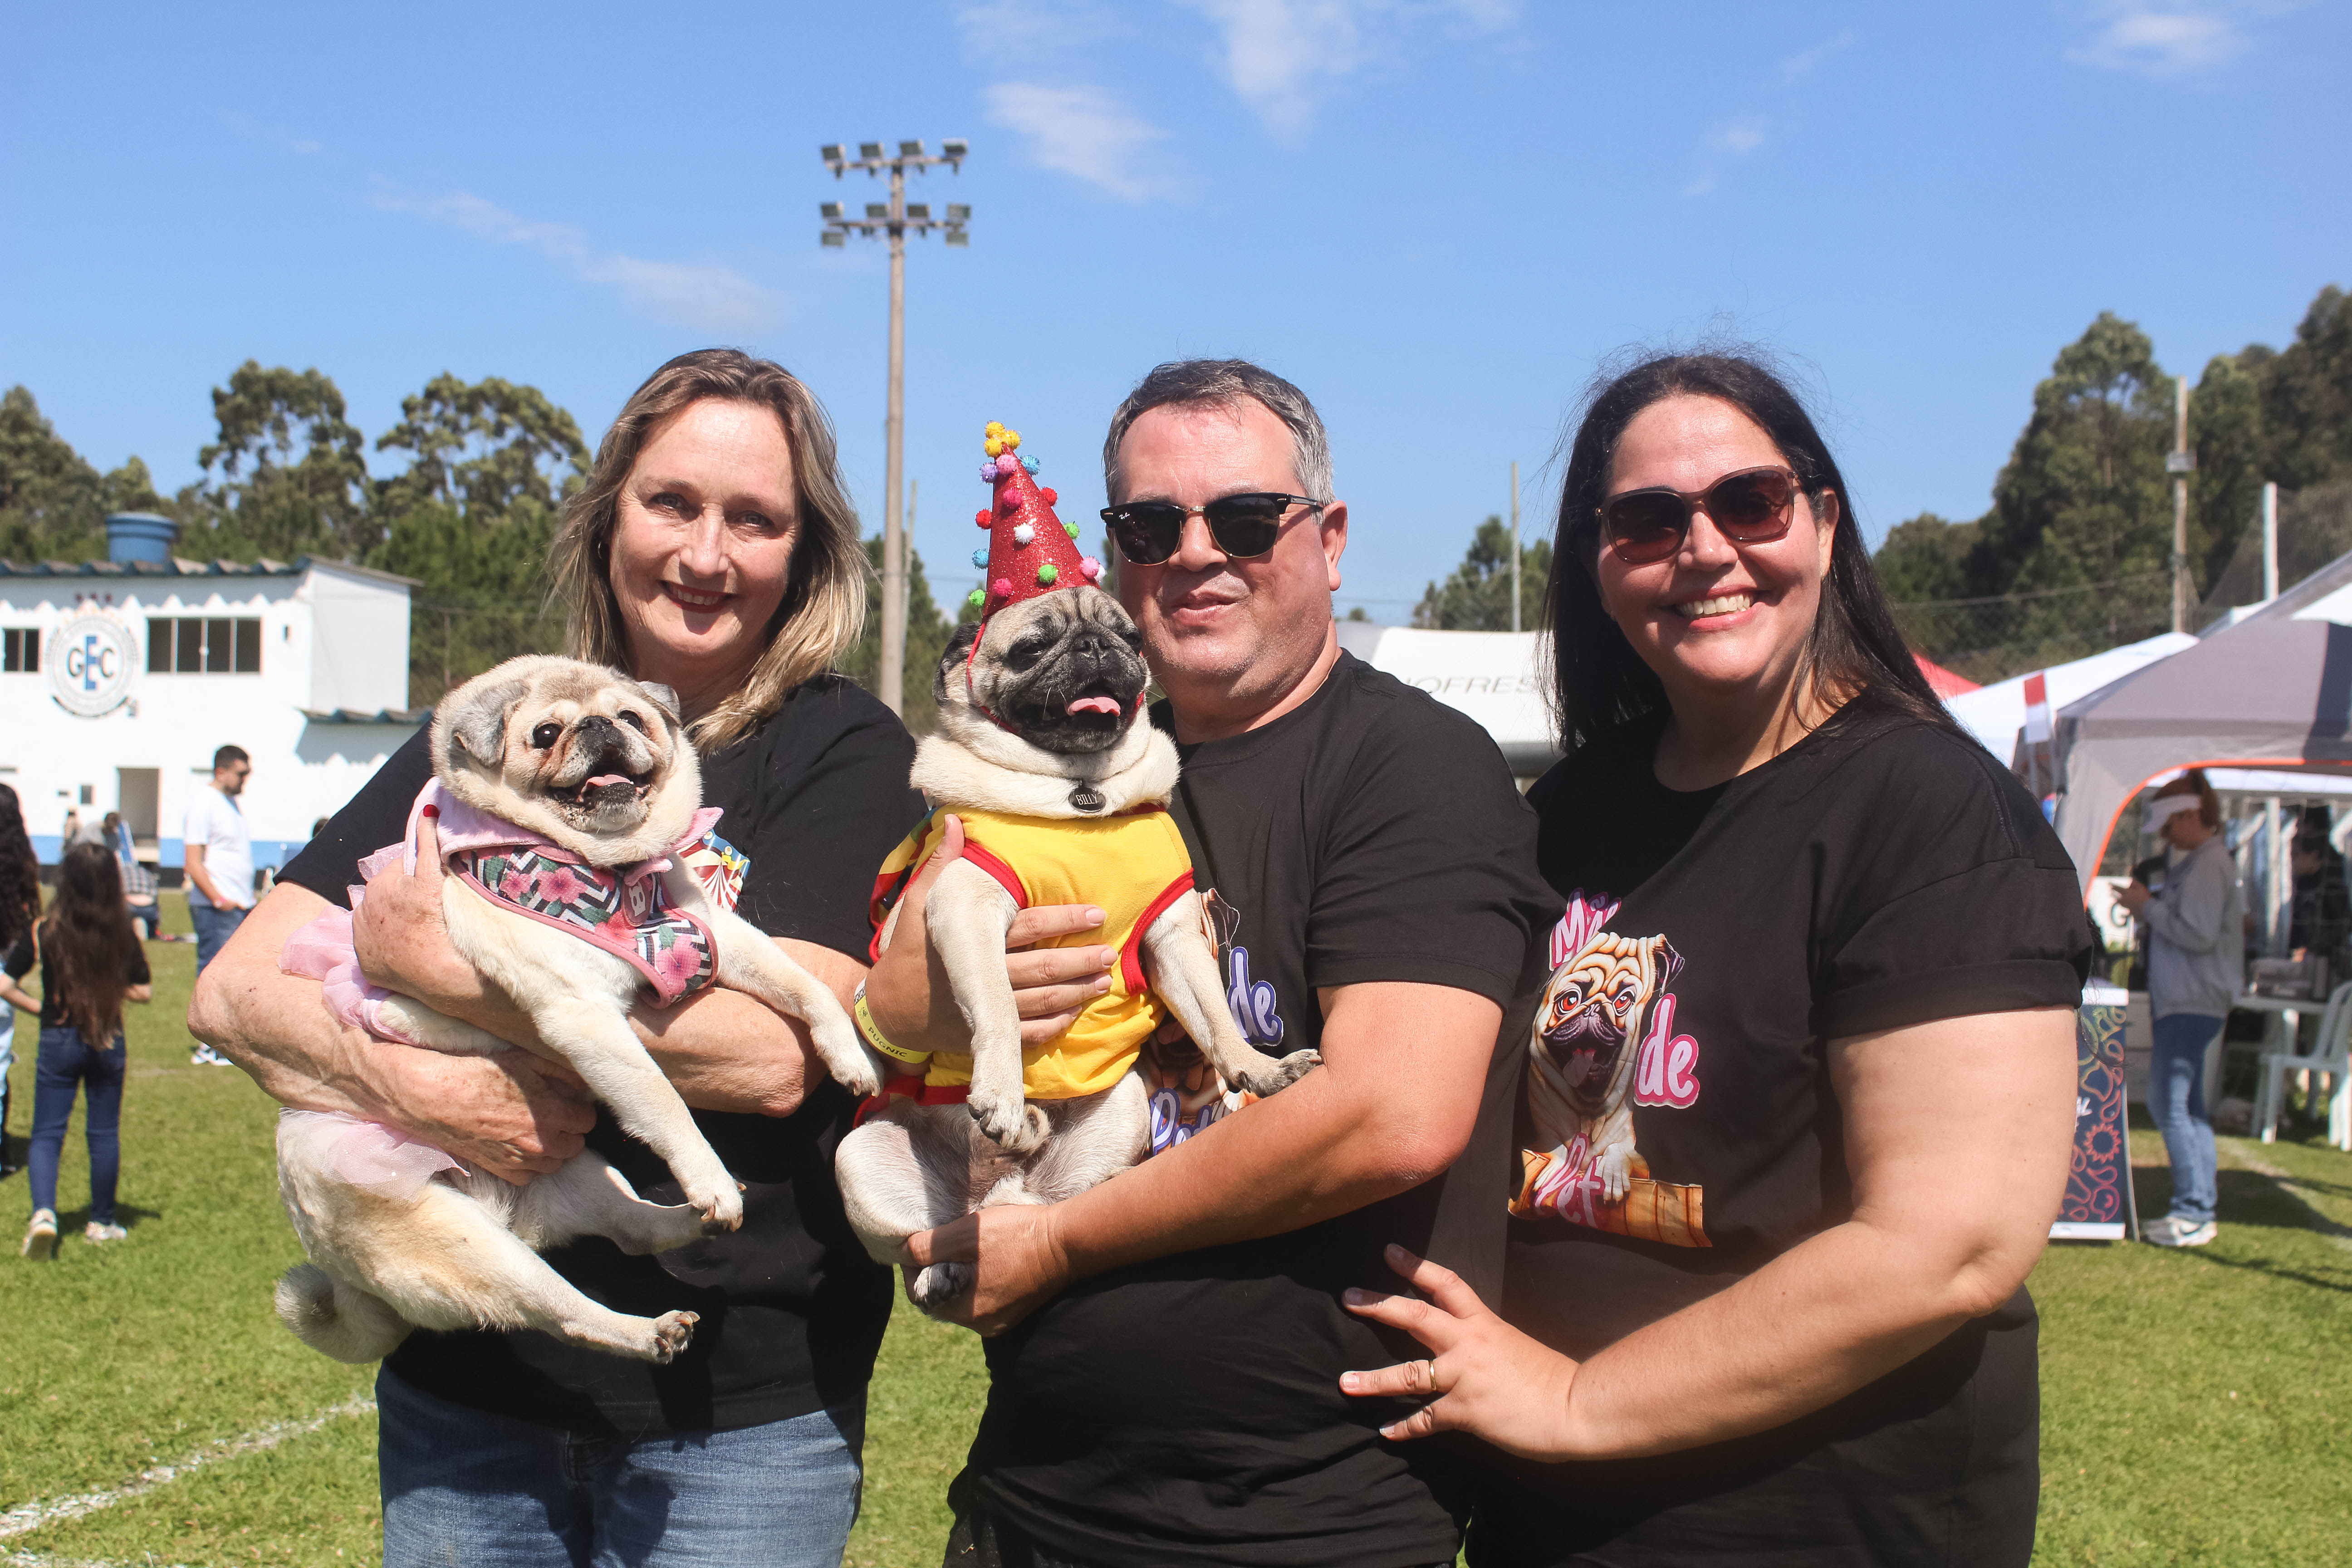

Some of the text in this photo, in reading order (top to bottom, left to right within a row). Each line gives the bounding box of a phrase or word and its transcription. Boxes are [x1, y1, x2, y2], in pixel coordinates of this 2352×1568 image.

[1405, 677, 1536, 694] OFRES
[1075, 794, 1098, 805] BILLY
[1230, 951, 1279, 1038] de
[868, 1026, 907, 1057] PUGNIC
[1637, 998, 1695, 1099] de
[1534, 1134, 1599, 1229] Pet
